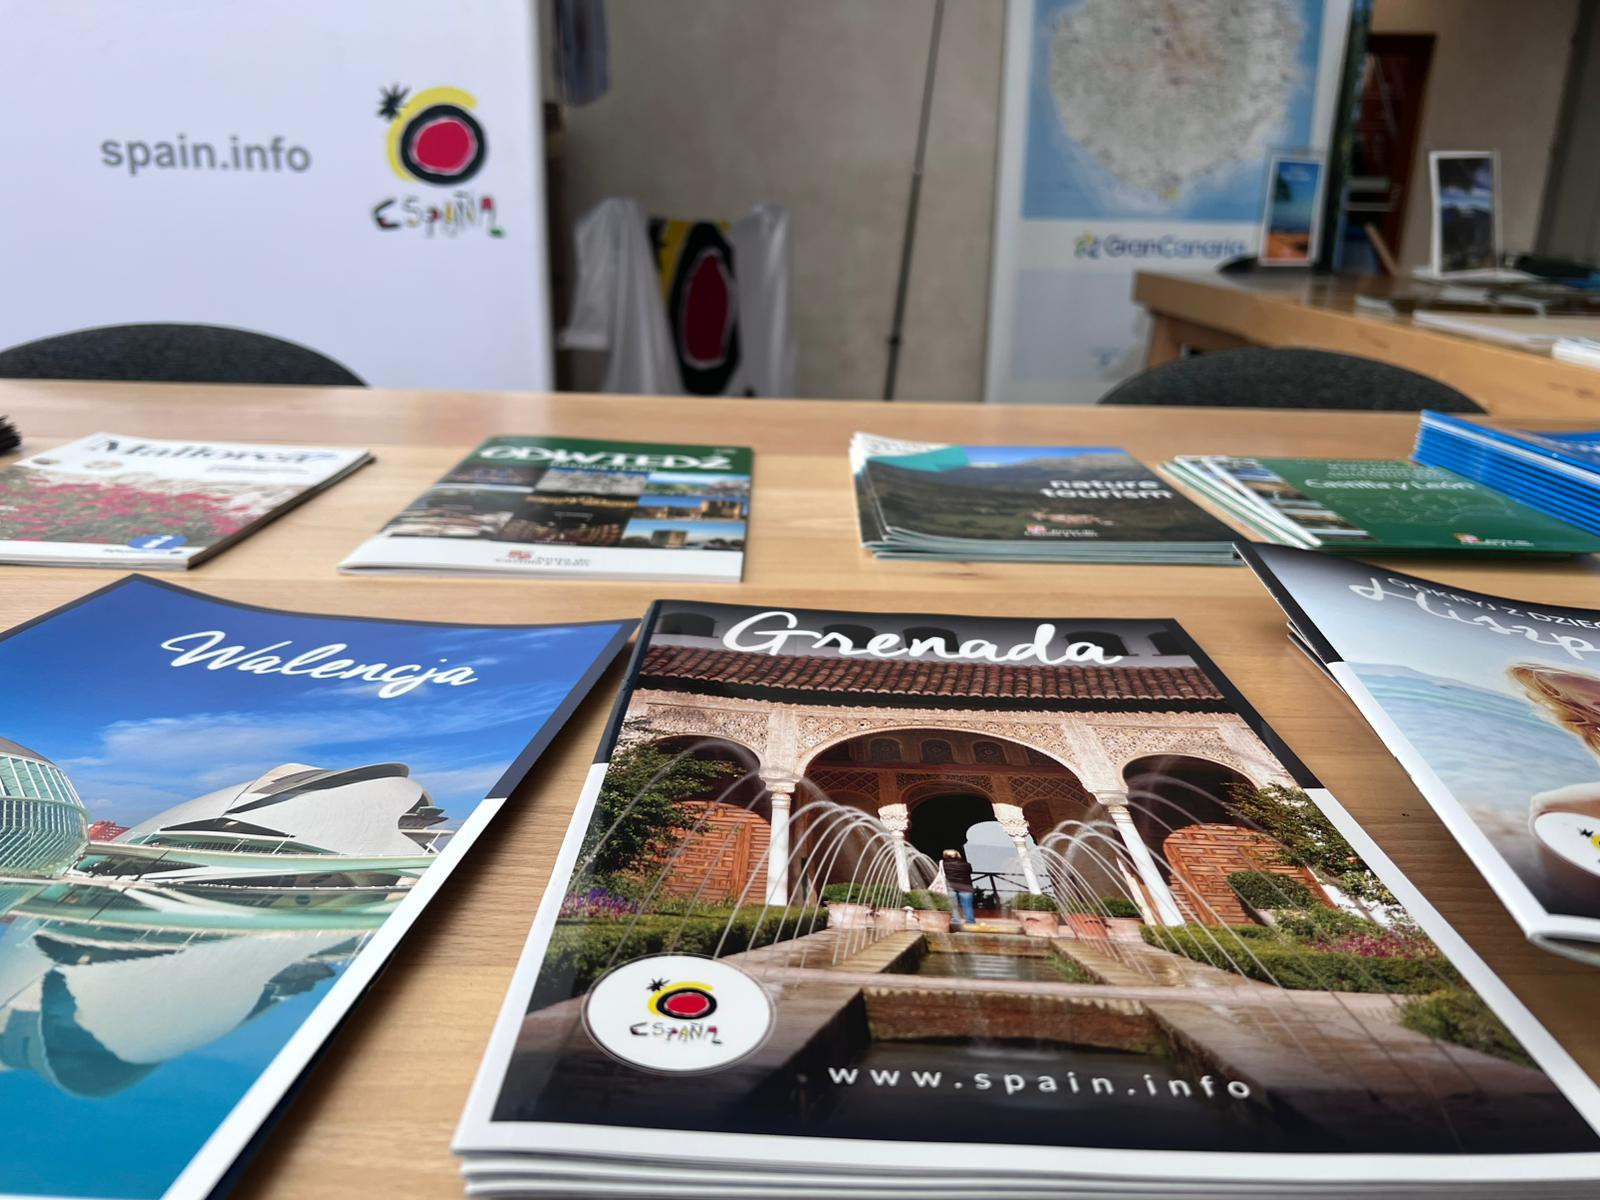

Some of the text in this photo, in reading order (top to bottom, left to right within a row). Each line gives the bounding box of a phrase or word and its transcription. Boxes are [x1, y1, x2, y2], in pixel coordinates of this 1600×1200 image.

[100, 134, 312, 176] spain.info
[1040, 487, 1173, 500] tourism
[1050, 479, 1160, 490] nature
[722, 610, 1123, 665] Grenada
[160, 630, 479, 699] Walencja
[827, 1065, 1252, 1100] www.spain.info
